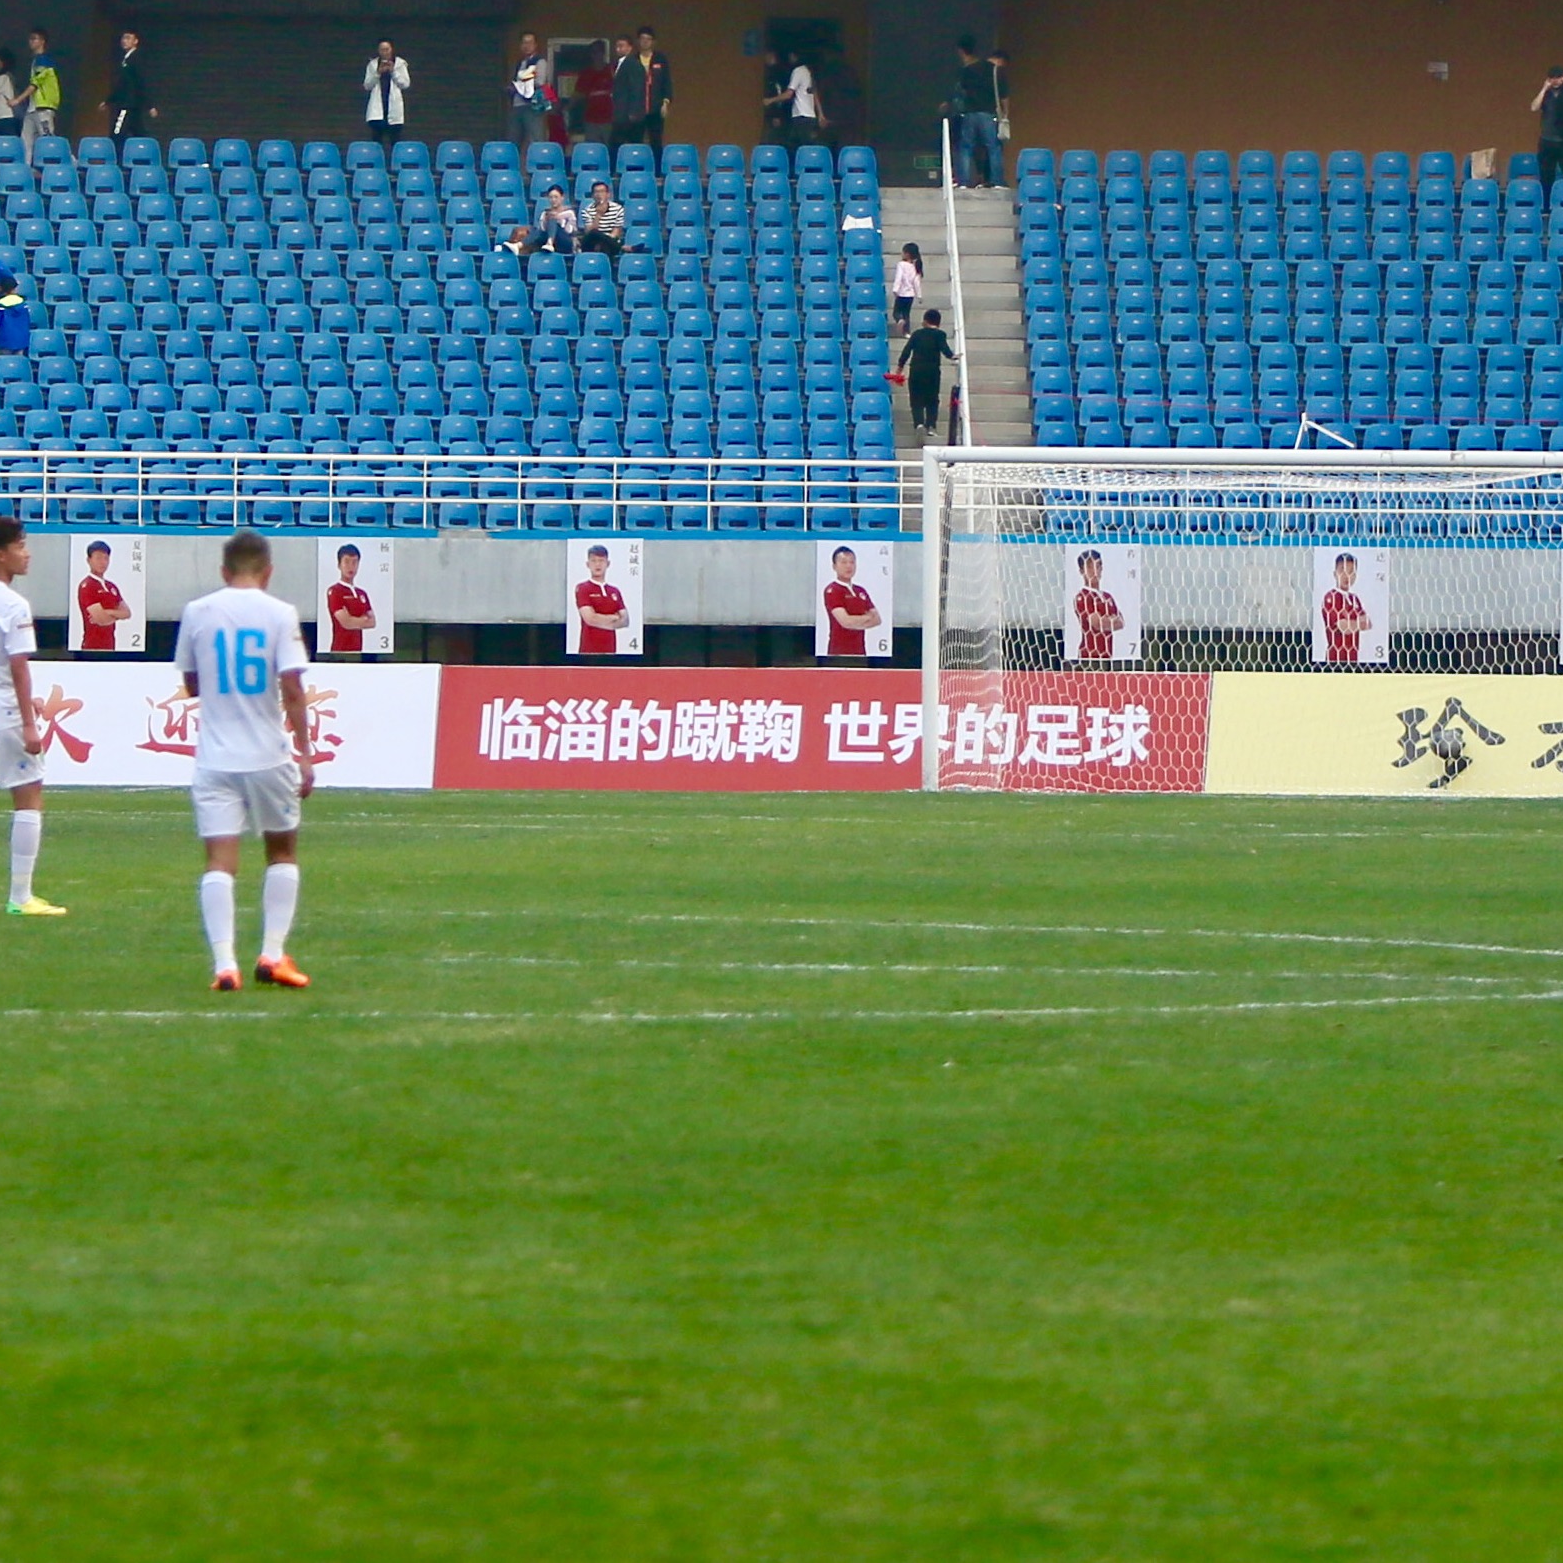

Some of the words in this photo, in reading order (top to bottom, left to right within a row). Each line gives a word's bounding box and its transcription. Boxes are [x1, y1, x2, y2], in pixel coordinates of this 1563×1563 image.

[130, 633, 142, 648] 2
[380, 636, 390, 650] 3
[628, 637, 639, 651] 4
[878, 639, 888, 653] 6
[1128, 641, 1138, 656] 7
[213, 626, 267, 695] 16
[479, 697, 803, 764] 临淄的蹴鞠
[823, 700, 1151, 767] 世界的足球
